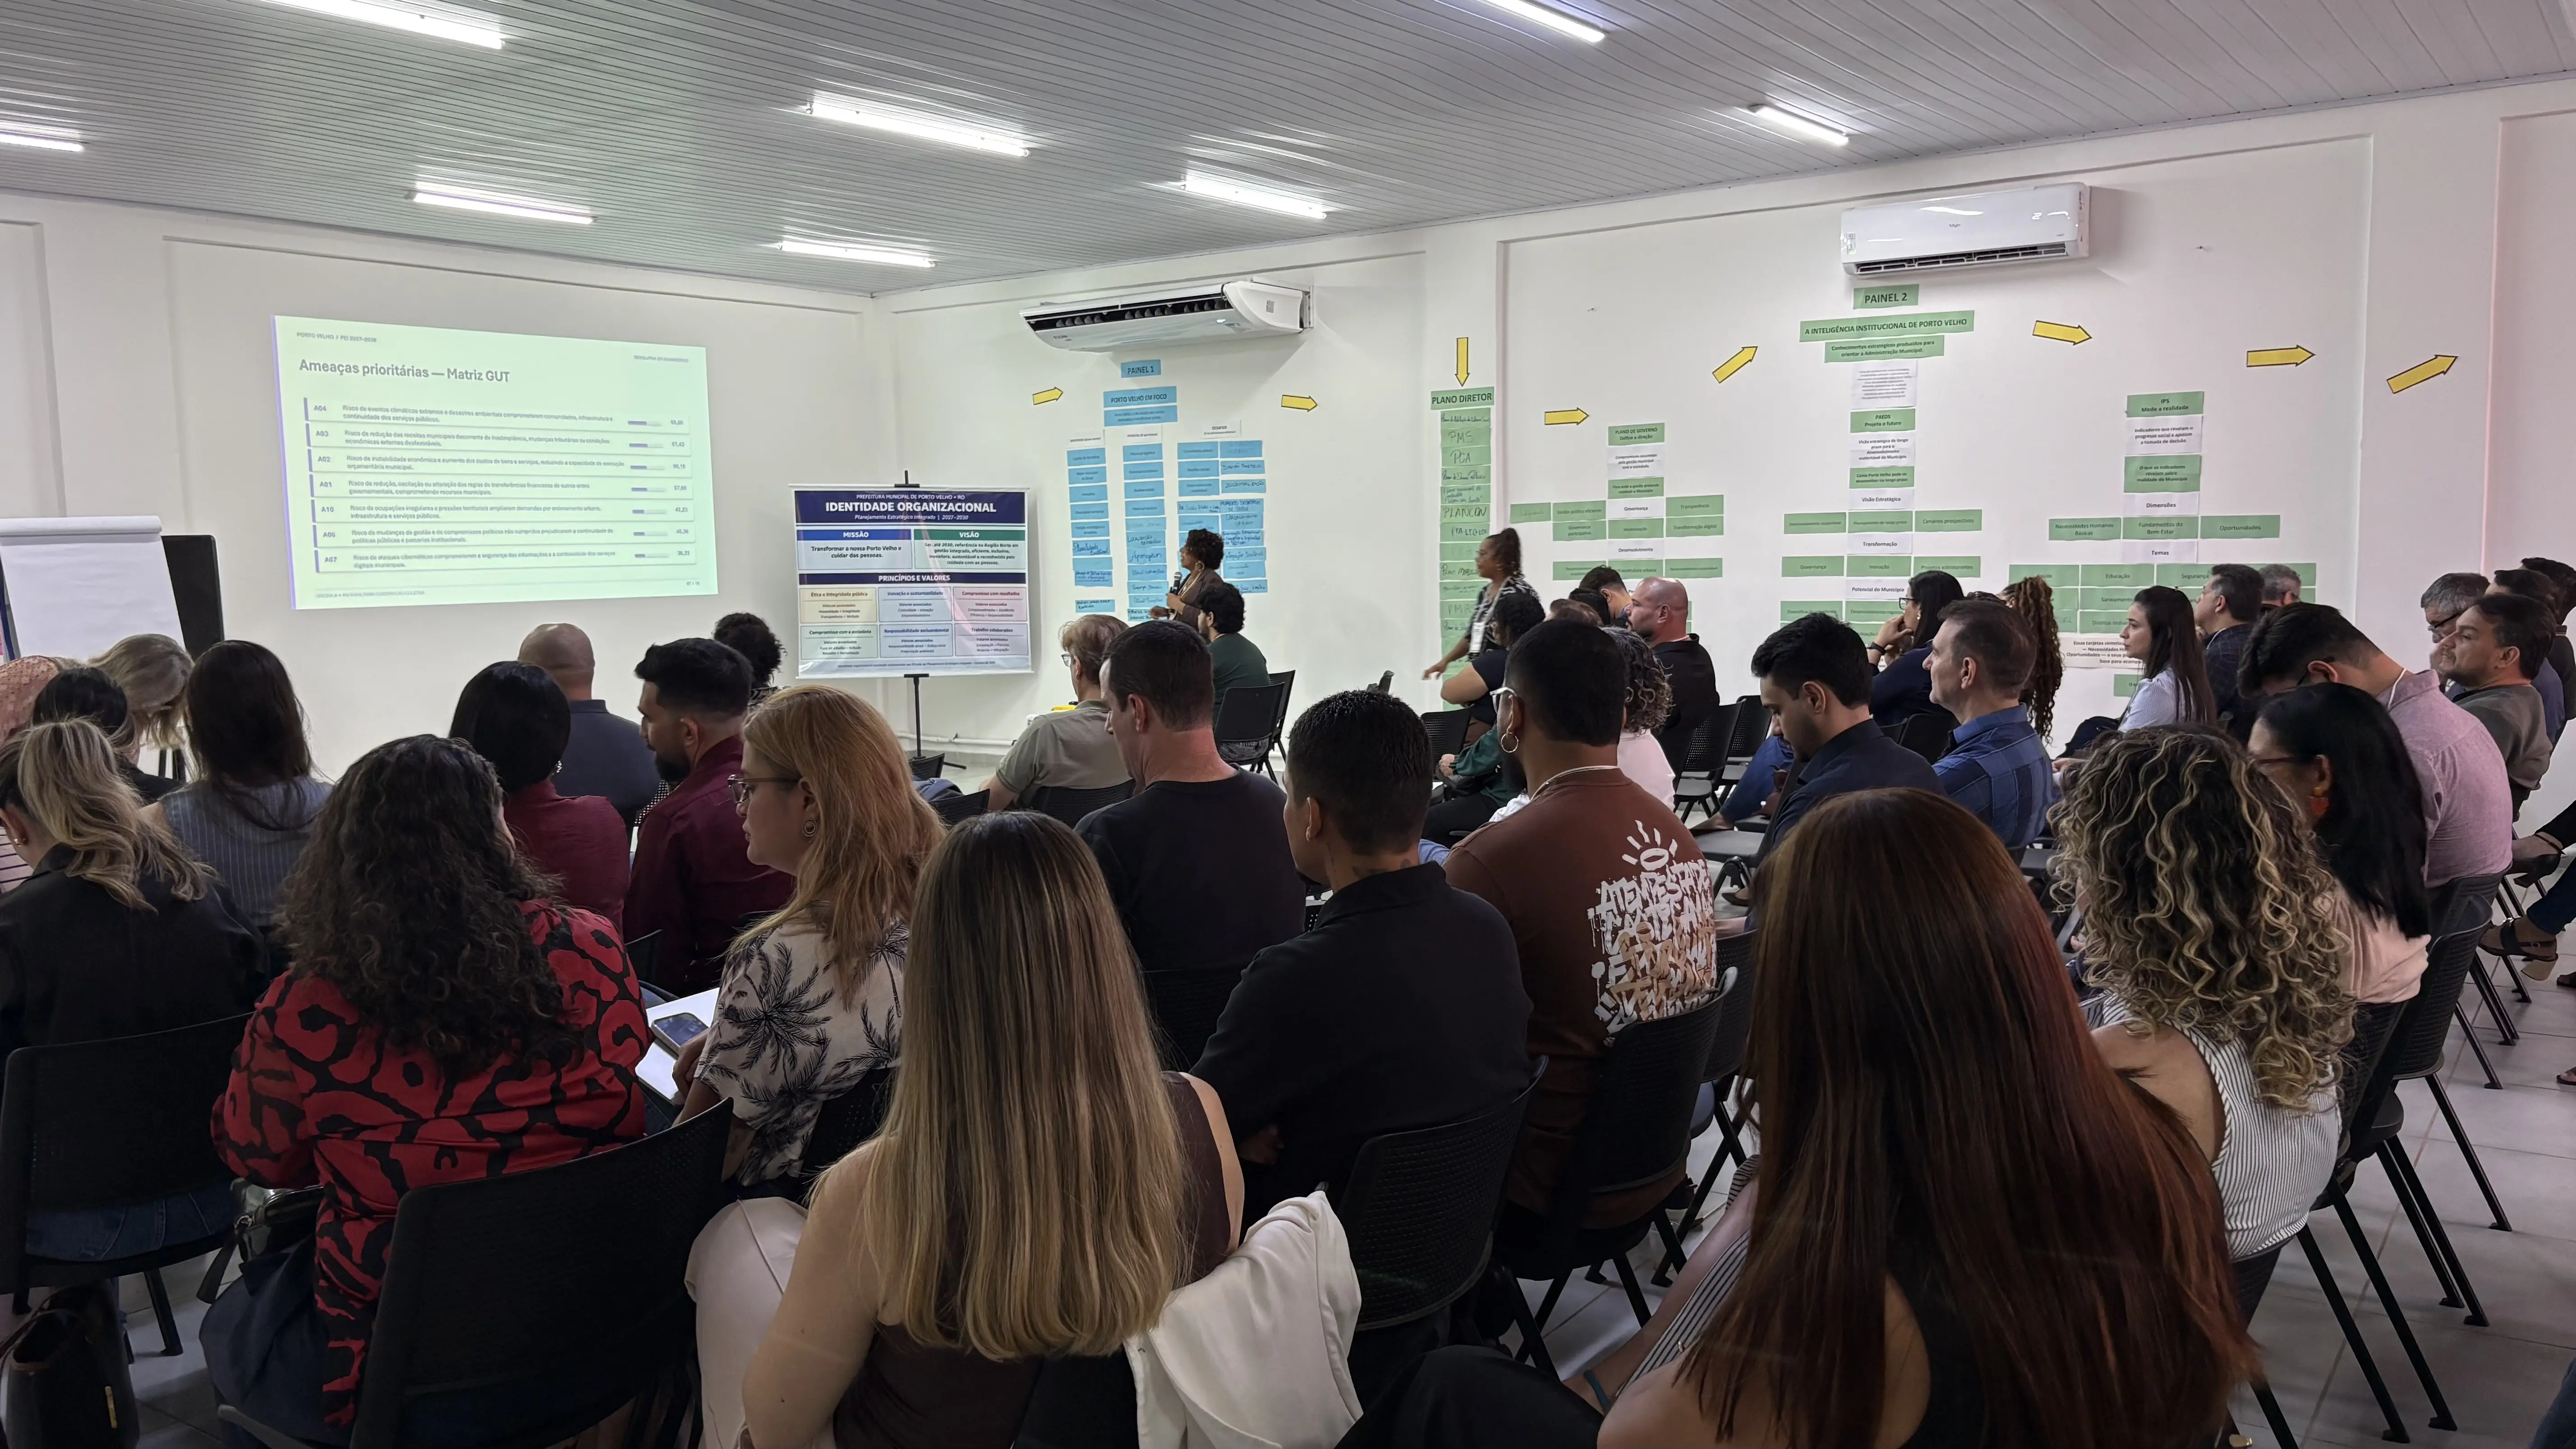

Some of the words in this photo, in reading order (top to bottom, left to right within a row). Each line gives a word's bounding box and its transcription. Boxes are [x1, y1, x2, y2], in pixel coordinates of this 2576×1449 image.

[1865, 293, 1899, 304] PAINEL
[1902, 293, 1907, 301] 2
[1811, 325, 1854, 334] INTELIGÊNCIA
[1856, 322, 1907, 331] INSTITUCIONAL
[299, 359, 359, 376] Ameaças
[363, 363, 429, 378] prioritárias
[447, 368, 483, 381] Matriz
[486, 370, 510, 382] GUT
[1127, 366, 1149, 374] PAINEL
[1432, 396, 1457, 404] PLANO
[1459, 393, 1492, 403] DIRETOR
[826, 502, 895, 512] IDENTIDADE
[897, 502, 997, 512] ORGANIZACIONAL
